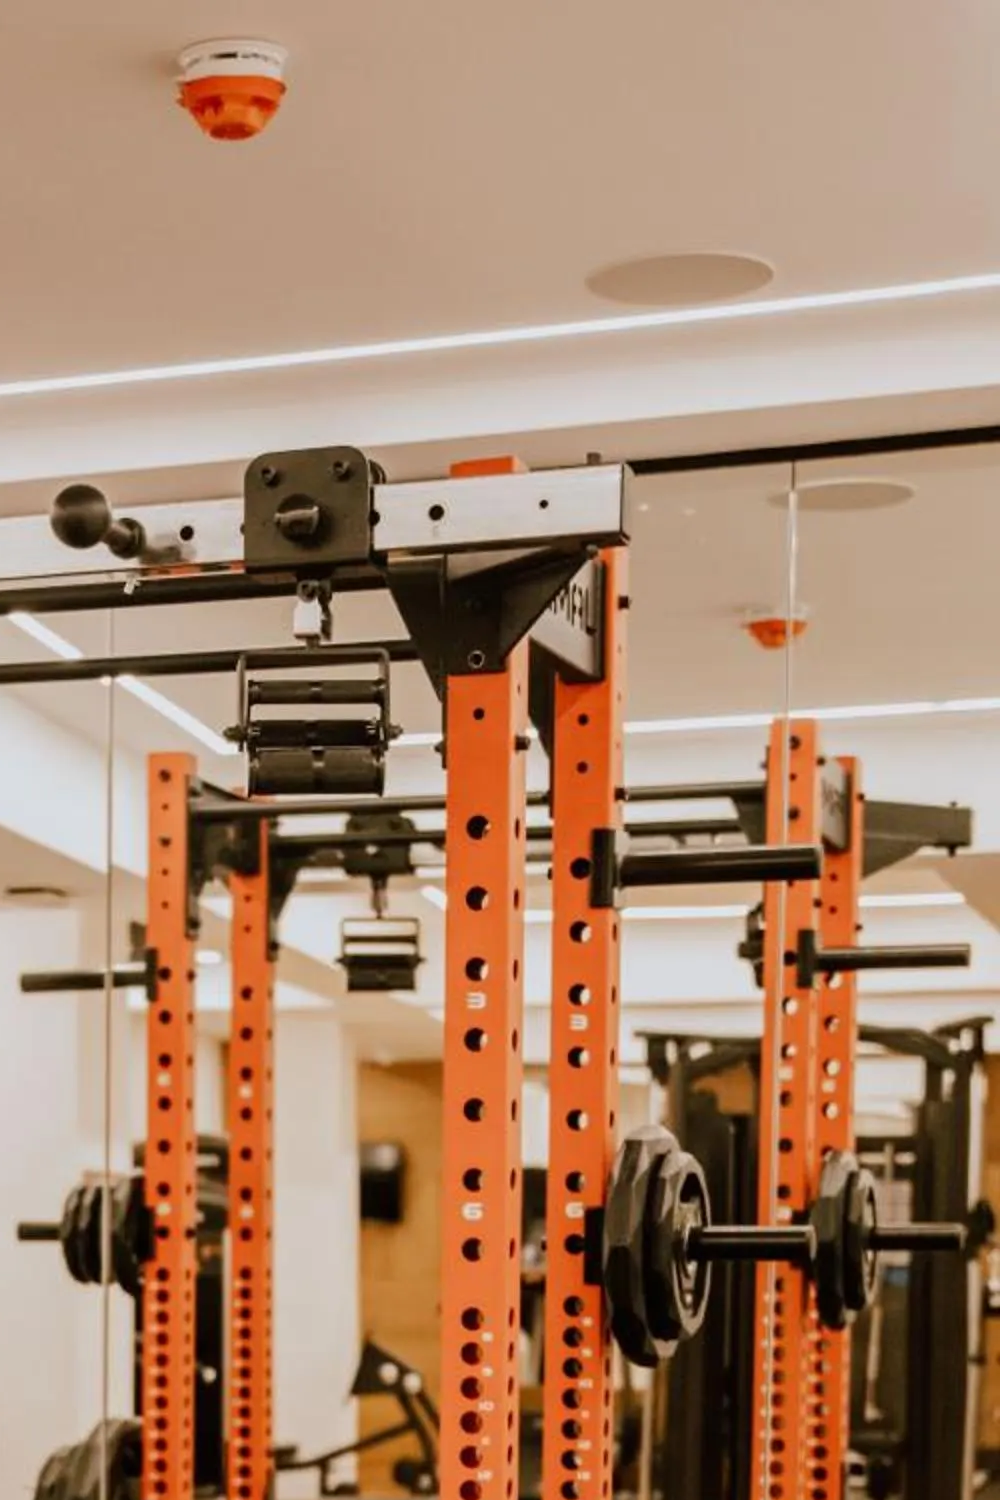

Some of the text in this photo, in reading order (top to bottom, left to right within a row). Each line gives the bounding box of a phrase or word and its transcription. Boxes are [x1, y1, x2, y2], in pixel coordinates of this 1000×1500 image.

[467, 992, 487, 1009] 3
[570, 1014, 589, 1030] 3
[462, 1203, 483, 1220] 6
